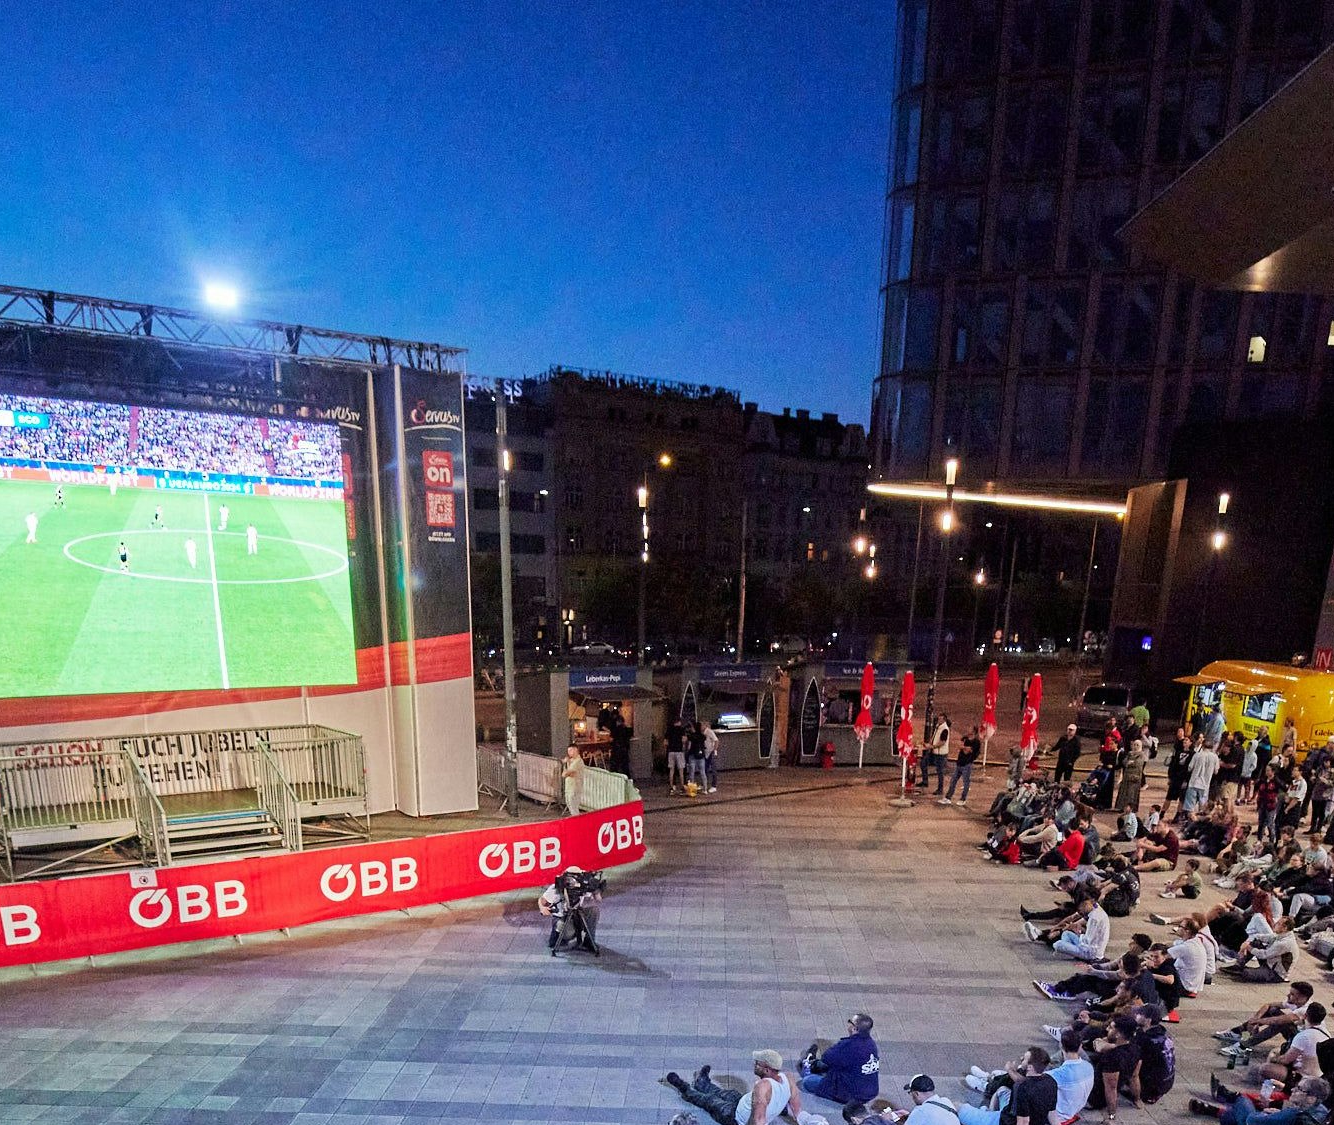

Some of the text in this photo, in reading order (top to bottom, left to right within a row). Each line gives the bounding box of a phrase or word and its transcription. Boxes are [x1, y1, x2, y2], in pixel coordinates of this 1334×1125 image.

[427, 467, 451, 483] on
[585, 675, 621, 683] Leberkas-Pepi
[598, 815, 644, 854] ÖBB
[478, 836, 562, 879] ÖBB
[320, 857, 419, 902] ÖBB
[129, 880, 248, 928] ÖBB
